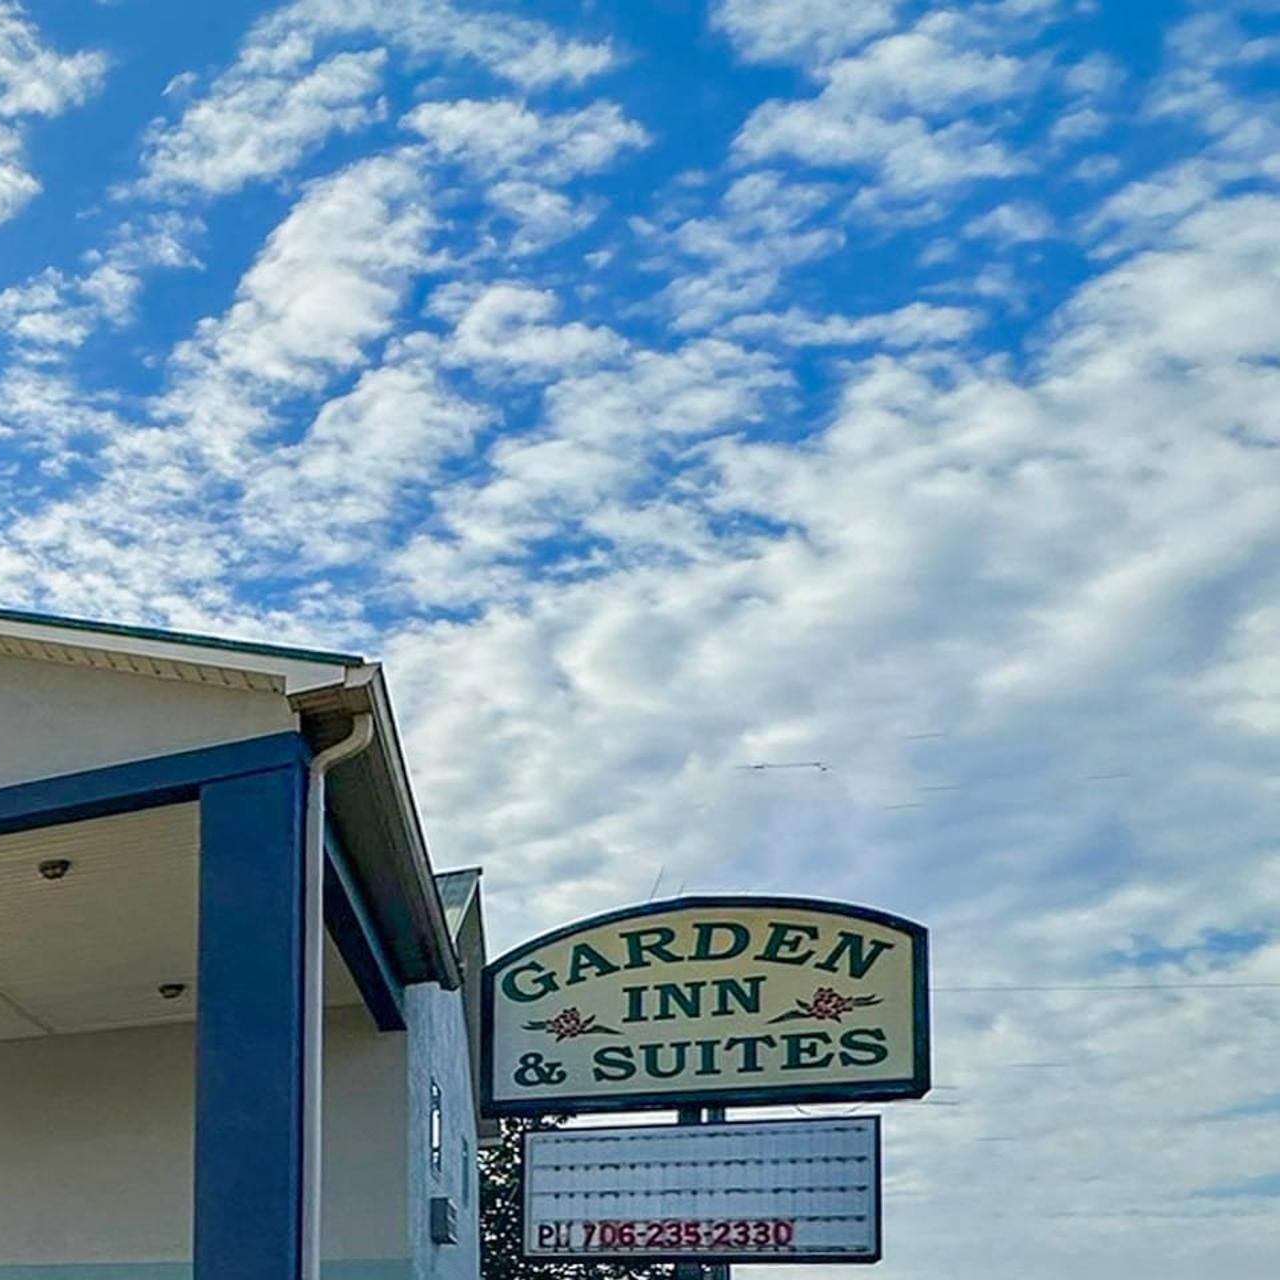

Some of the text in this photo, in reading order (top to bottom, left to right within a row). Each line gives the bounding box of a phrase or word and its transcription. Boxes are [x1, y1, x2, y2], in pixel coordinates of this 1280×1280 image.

[501, 921, 894, 1004] GARDEN
[622, 976, 767, 1023] INN
[514, 1028, 889, 1087] & SUITES
[583, 1219, 793, 1248] 706-235-2330
